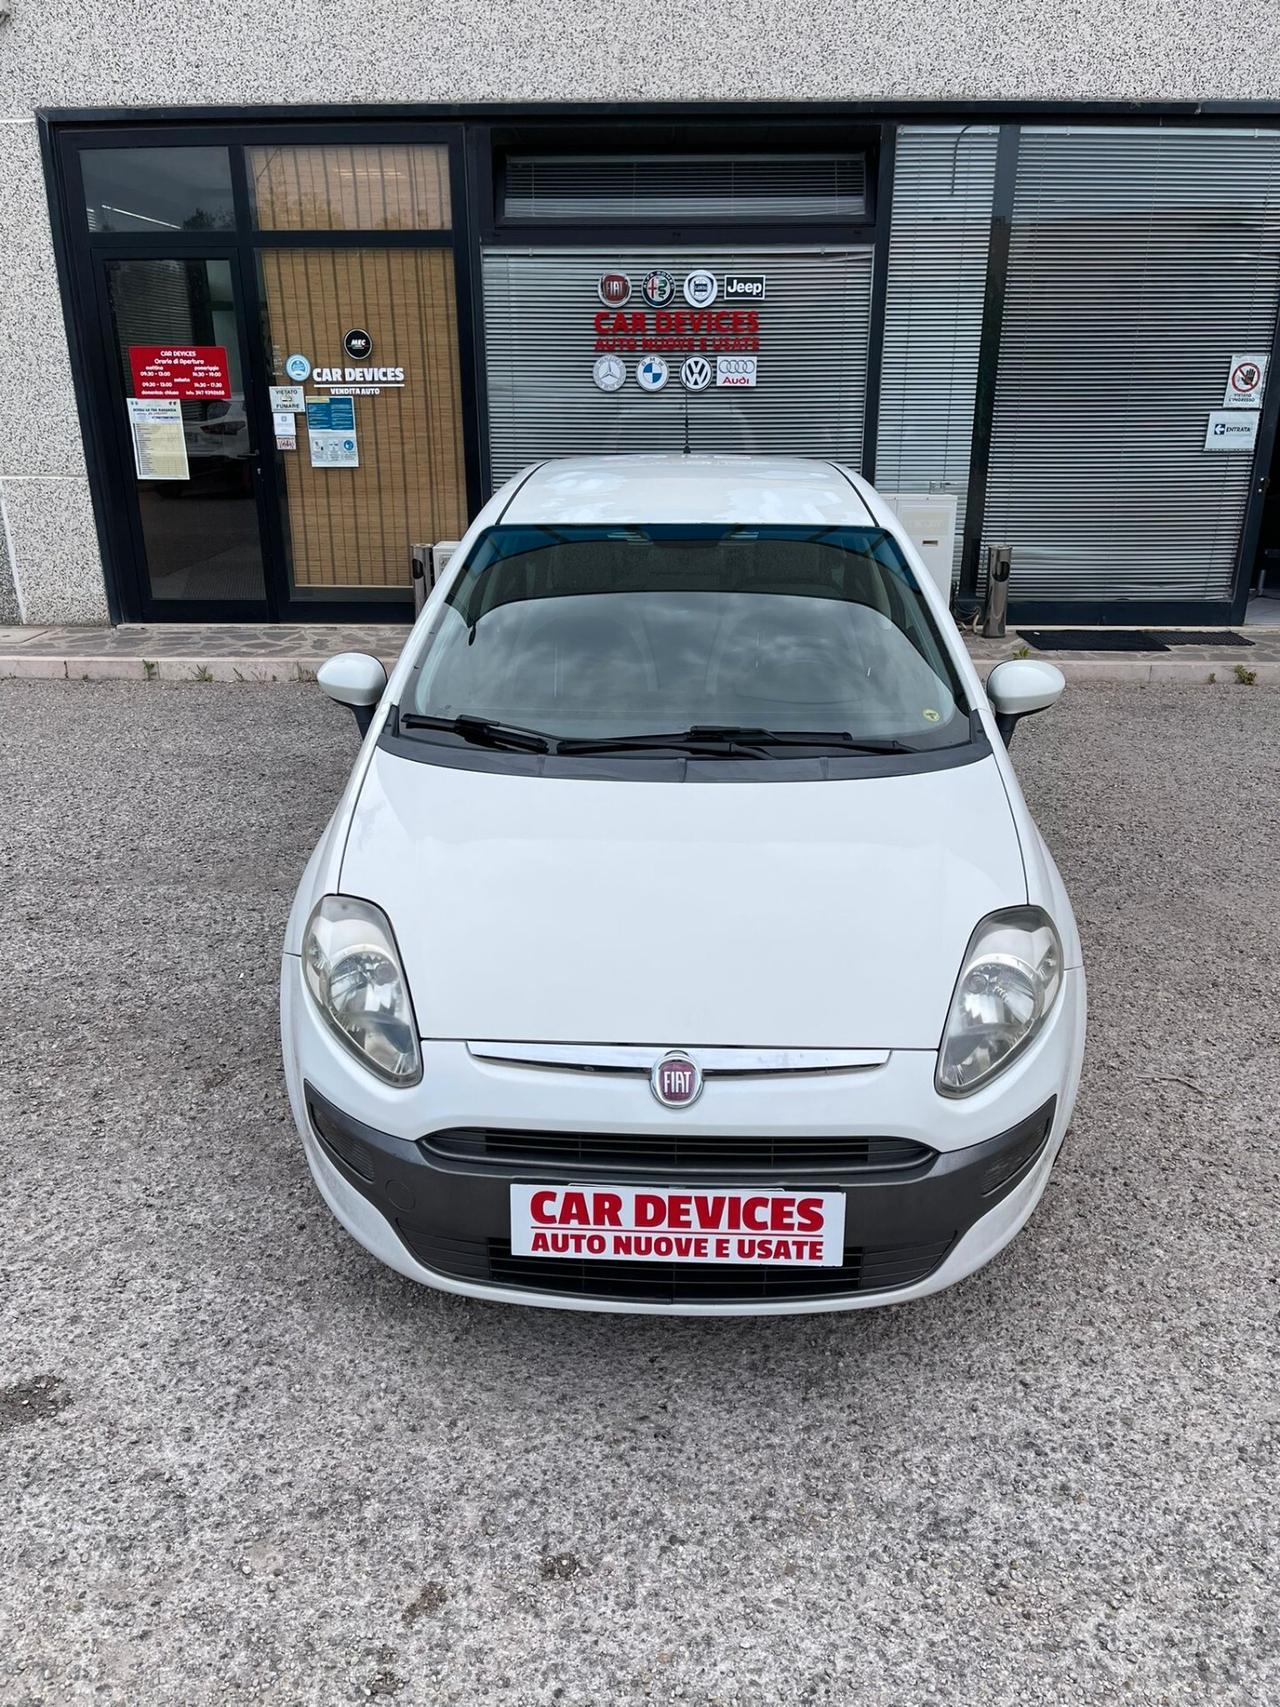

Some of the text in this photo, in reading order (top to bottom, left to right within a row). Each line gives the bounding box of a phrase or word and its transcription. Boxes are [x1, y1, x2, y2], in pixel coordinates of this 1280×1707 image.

[606, 281, 624, 294] FIAT
[727, 279, 762, 296] Jeep
[593, 310, 760, 333] CAR DEVICES
[351, 338, 366, 346] MEC
[593, 336, 637, 351] AUTO
[312, 367, 343, 382] CAR
[344, 367, 405, 382] DEVICES
[722, 376, 750, 385] Audi
[330, 387, 380, 396] VENDITA AUTO
[663, 1070, 692, 1094] FIAT
[529, 1190, 825, 1232] CAR DEVICES
[531, 1232, 824, 1260] AUTO NUOVE E USATE
